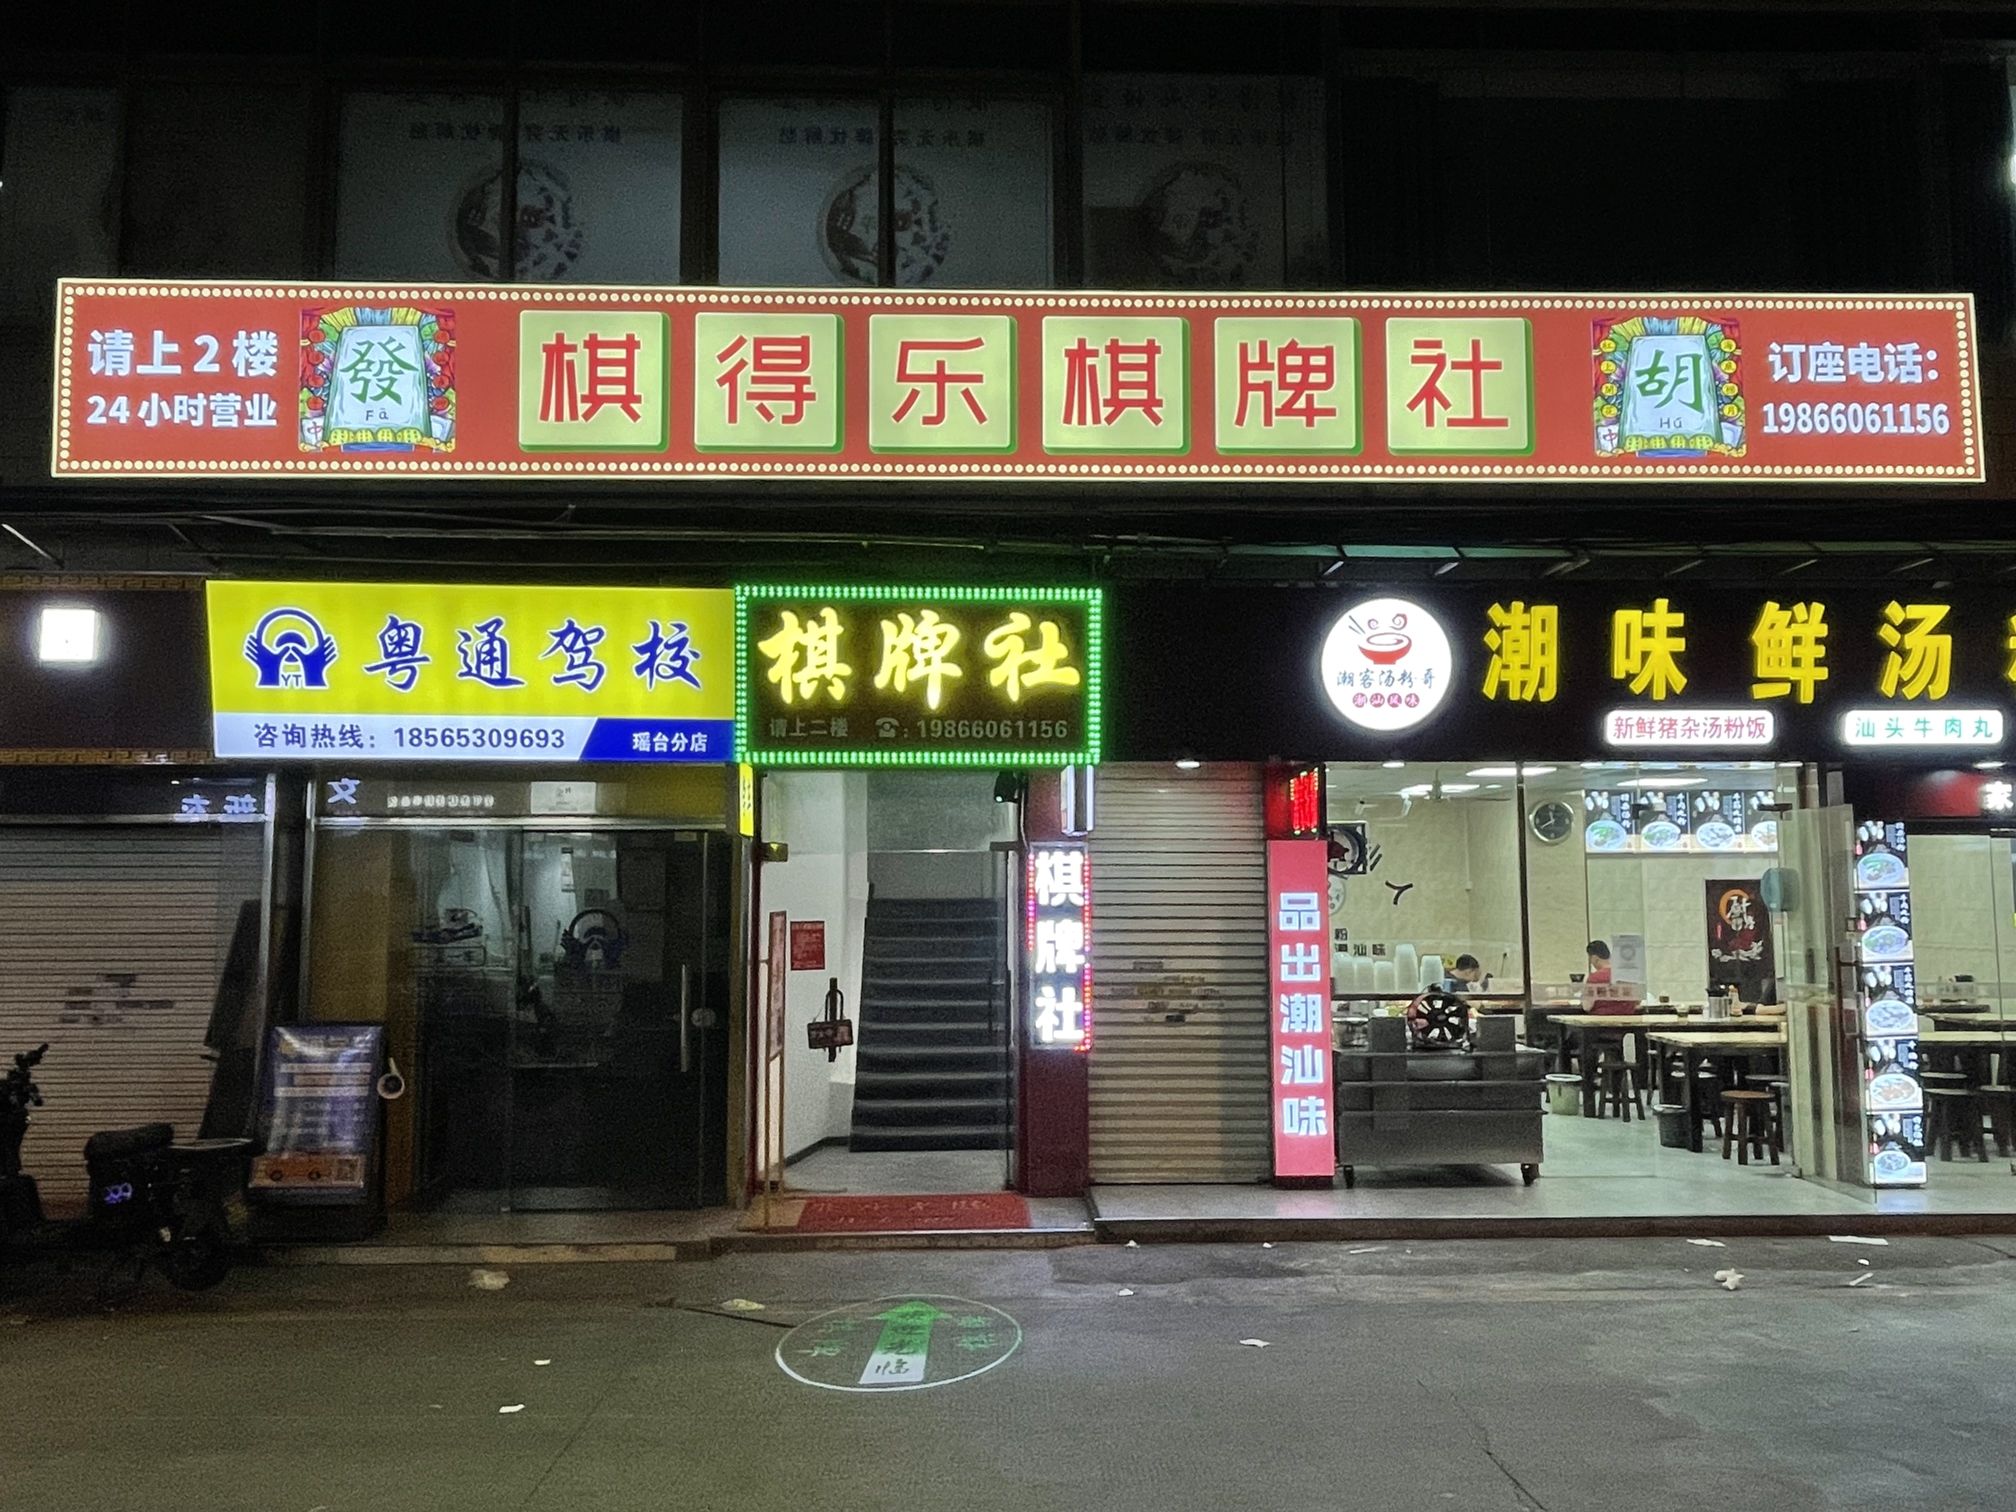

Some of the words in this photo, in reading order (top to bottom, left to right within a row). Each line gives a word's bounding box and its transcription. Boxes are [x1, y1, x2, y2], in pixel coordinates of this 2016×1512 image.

[87, 330, 278, 377] 请上2楼
[340, 336, 418, 404] 發
[1635, 349, 1704, 414] 胡
[87, 394, 277, 428] 24小时营业
[1762, 402, 1950, 435] 19866061156
[364, 615, 702, 691] 粤通驾校
[757, 607, 1080, 710] 棋牌社
[632, 732, 708, 753] 瑶台分店
[770, 717, 848, 738] 请上二楼
[1613, 716, 1766, 741] 新鲜猪杂汤粉饭
[1855, 715, 1993, 740] 汕头牛肉丸
[1034, 850, 1085, 1043] 棋牌社
[1279, 892, 1328, 1136] 品出潮汕味
